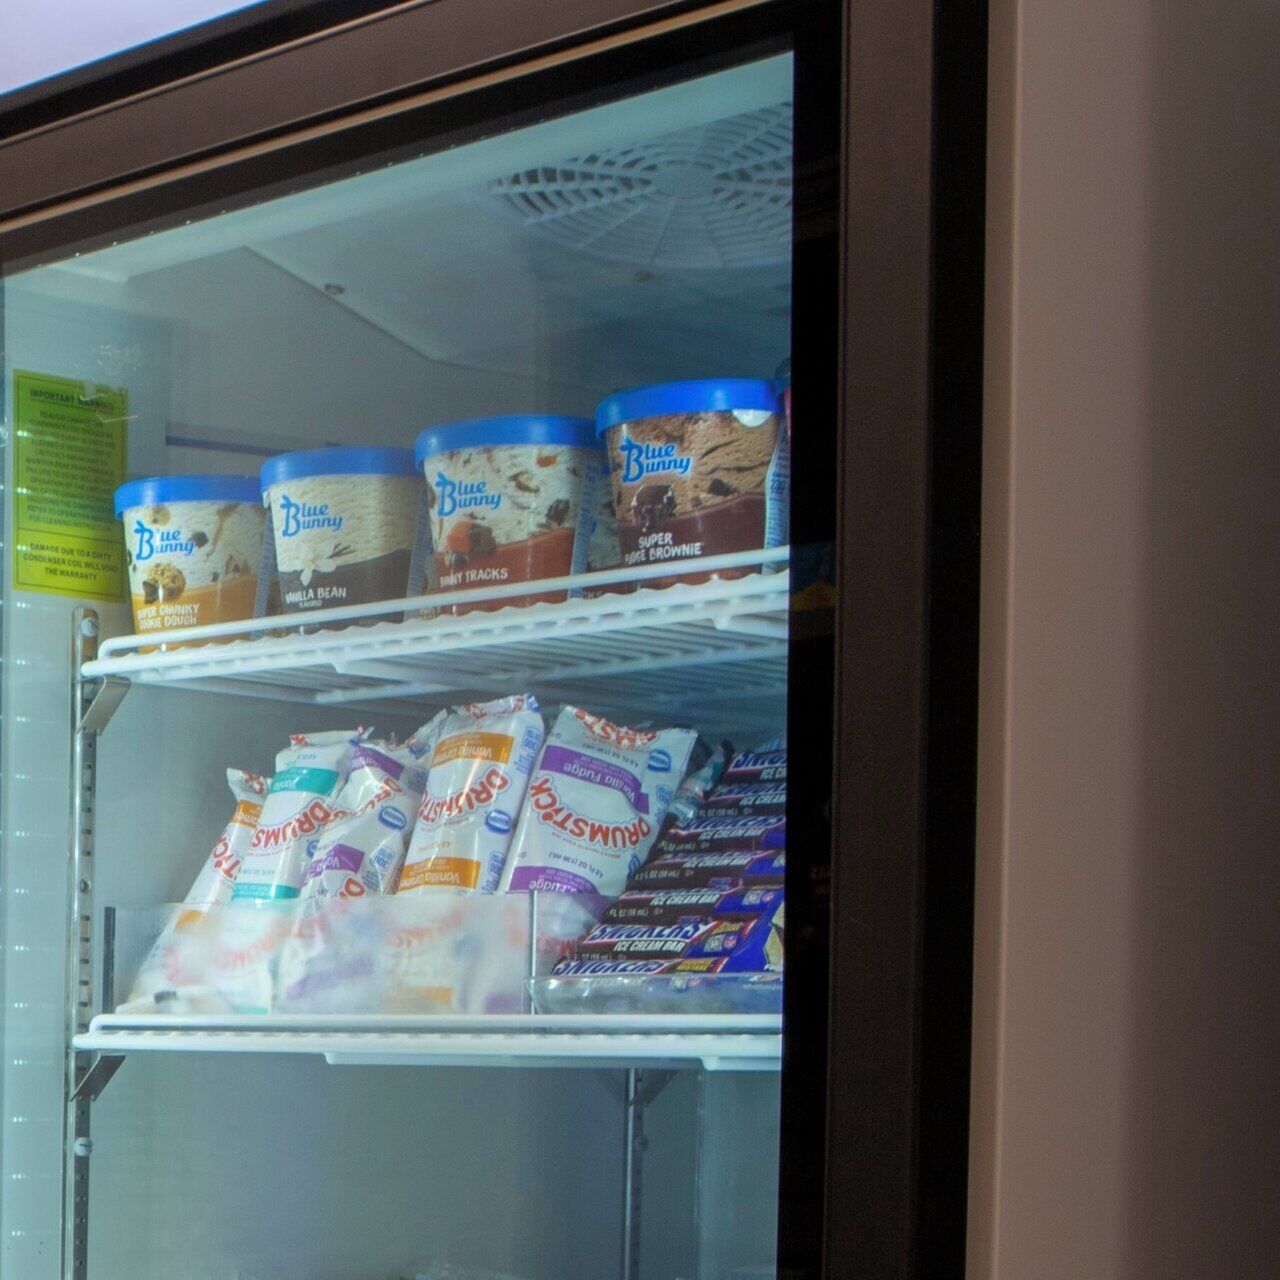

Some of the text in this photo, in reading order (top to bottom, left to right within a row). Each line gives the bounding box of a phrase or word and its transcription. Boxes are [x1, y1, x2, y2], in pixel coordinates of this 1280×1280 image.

[29, 388, 75, 404] IMPORTANT
[638, 532, 673, 549] SUPER
[29, 542, 60, 554] DAMAGE
[60, 547, 75, 556] DUE
[648, 542, 703, 561] BROWNIE
[23, 553, 66, 566] CONDENSER
[67, 559, 83, 568] COIL
[45, 566, 97, 581] THE WARRANTY
[464, 567, 508, 583] TRACKS
[285, 586, 347, 604] VANILLA BEAN
[159, 603, 200, 616] CHUNKY
[164, 614, 197, 627] DOUGH
[562, 762, 602, 783] Fudge
[529, 776, 651, 849] DRUMSTICK
[251, 799, 331, 849] DRUMS
[649, 893, 720, 907] ICE CREAM BAR
[613, 941, 687, 953] ICE CREAM BAR
